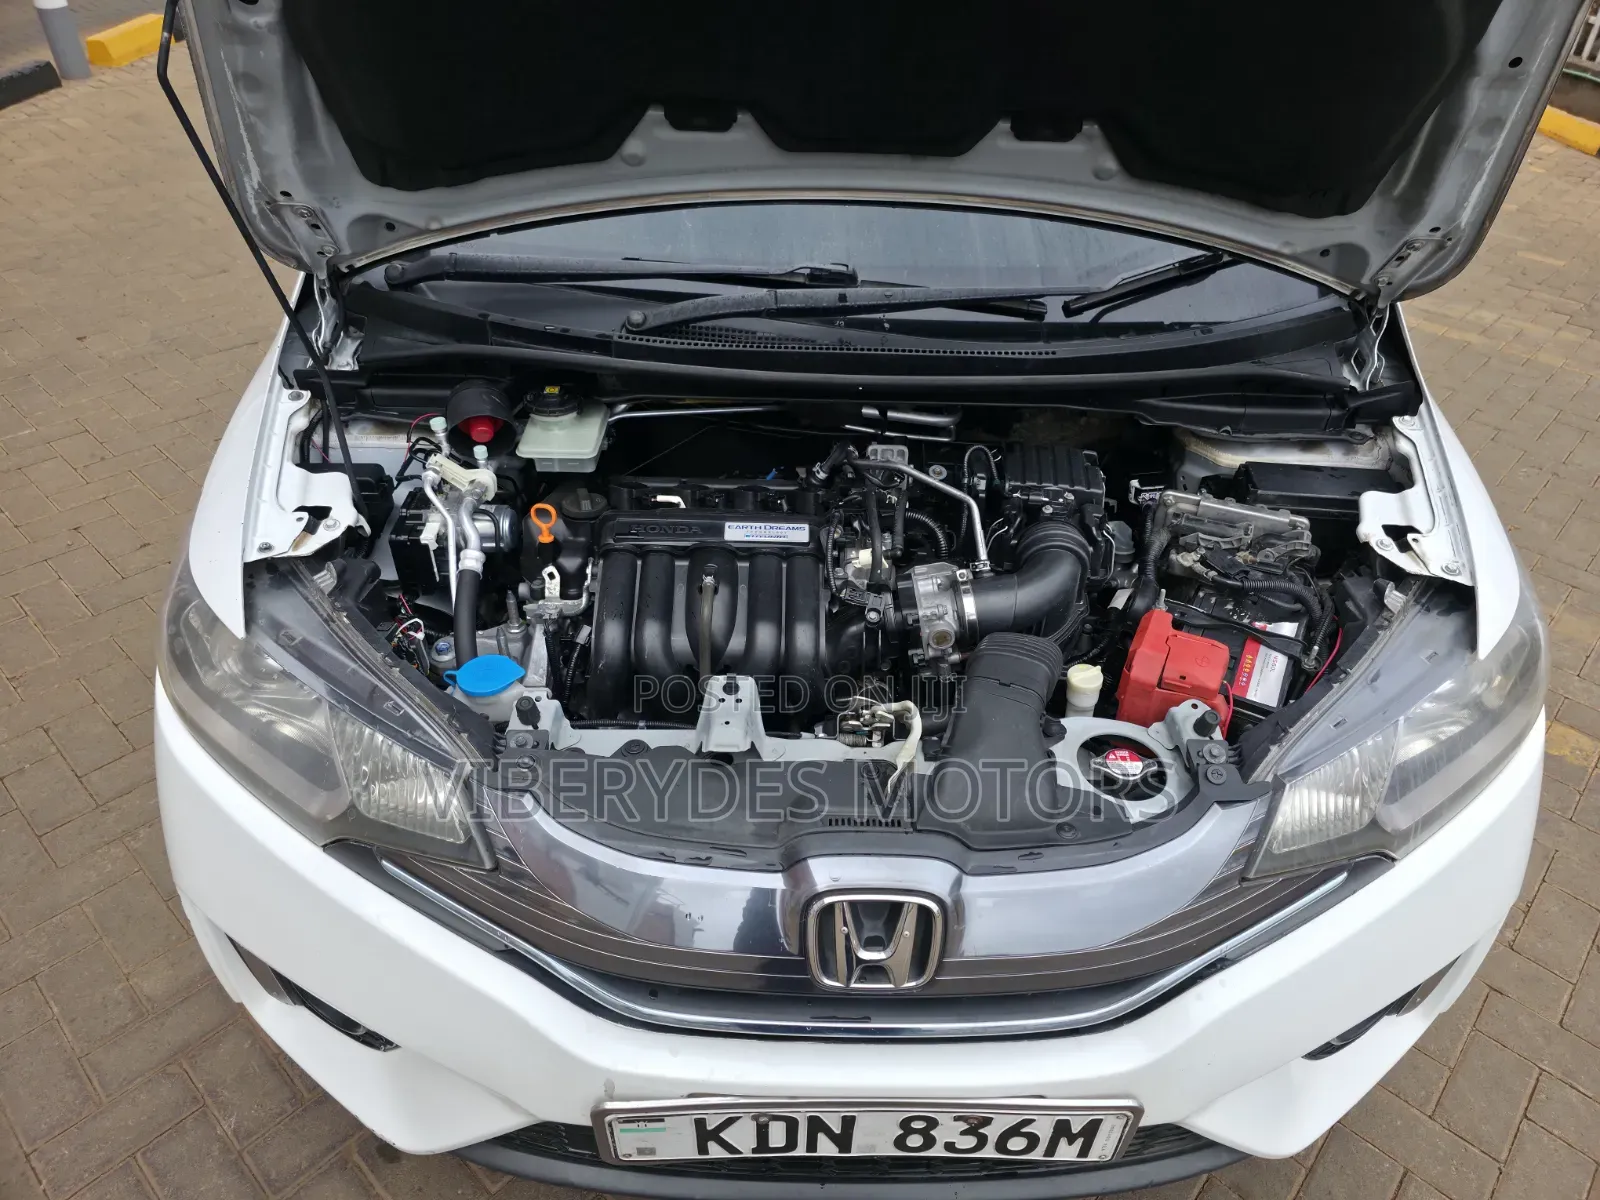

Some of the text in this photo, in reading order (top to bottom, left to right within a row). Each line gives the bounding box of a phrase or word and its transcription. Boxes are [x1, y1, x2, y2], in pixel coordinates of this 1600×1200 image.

[629, 524, 703, 534] HONDA
[693, 1114, 857, 1156] KDN
[893, 1114, 1104, 1159] 836M
